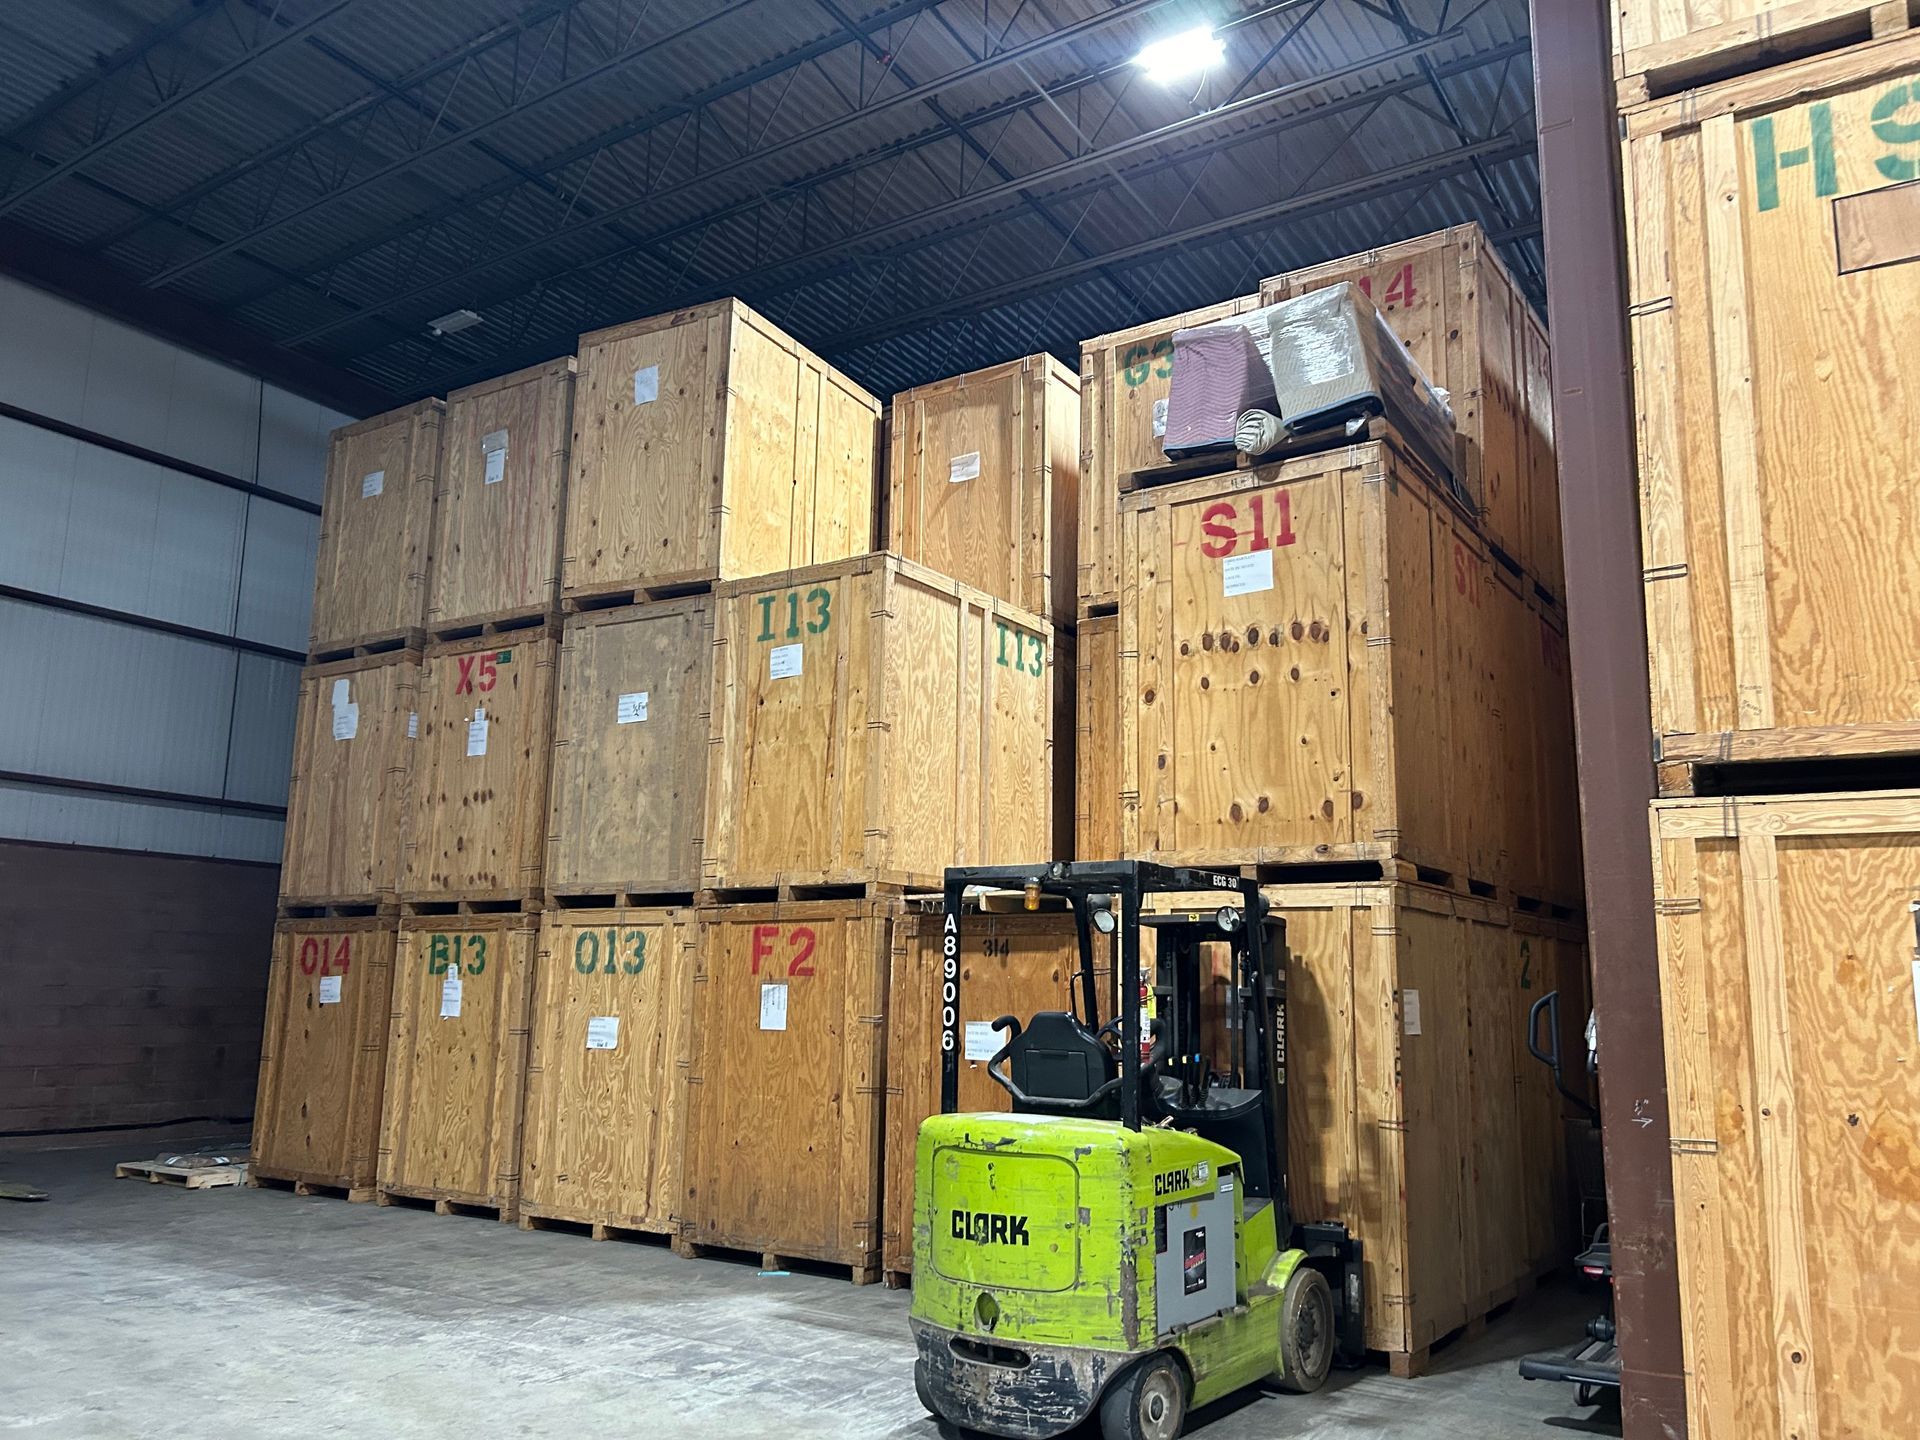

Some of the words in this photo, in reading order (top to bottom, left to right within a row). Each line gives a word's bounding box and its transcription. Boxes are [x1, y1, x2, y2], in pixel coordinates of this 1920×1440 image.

[757, 587, 832, 642] I13
[996, 622, 1043, 678] I13
[455, 653, 497, 695] X5
[1213, 875, 1227, 887] ECG
[1227, 877, 1237, 889] 30
[429, 934, 486, 976] B13
[752, 920, 815, 978] F2
[983, 938, 1010, 957] 314
[942, 913, 958, 1051] A89006
[1277, 1004, 1285, 1063] CLARK
[1155, 1167, 1190, 1197] CLARK
[951, 1207, 1029, 1247] CLARK
